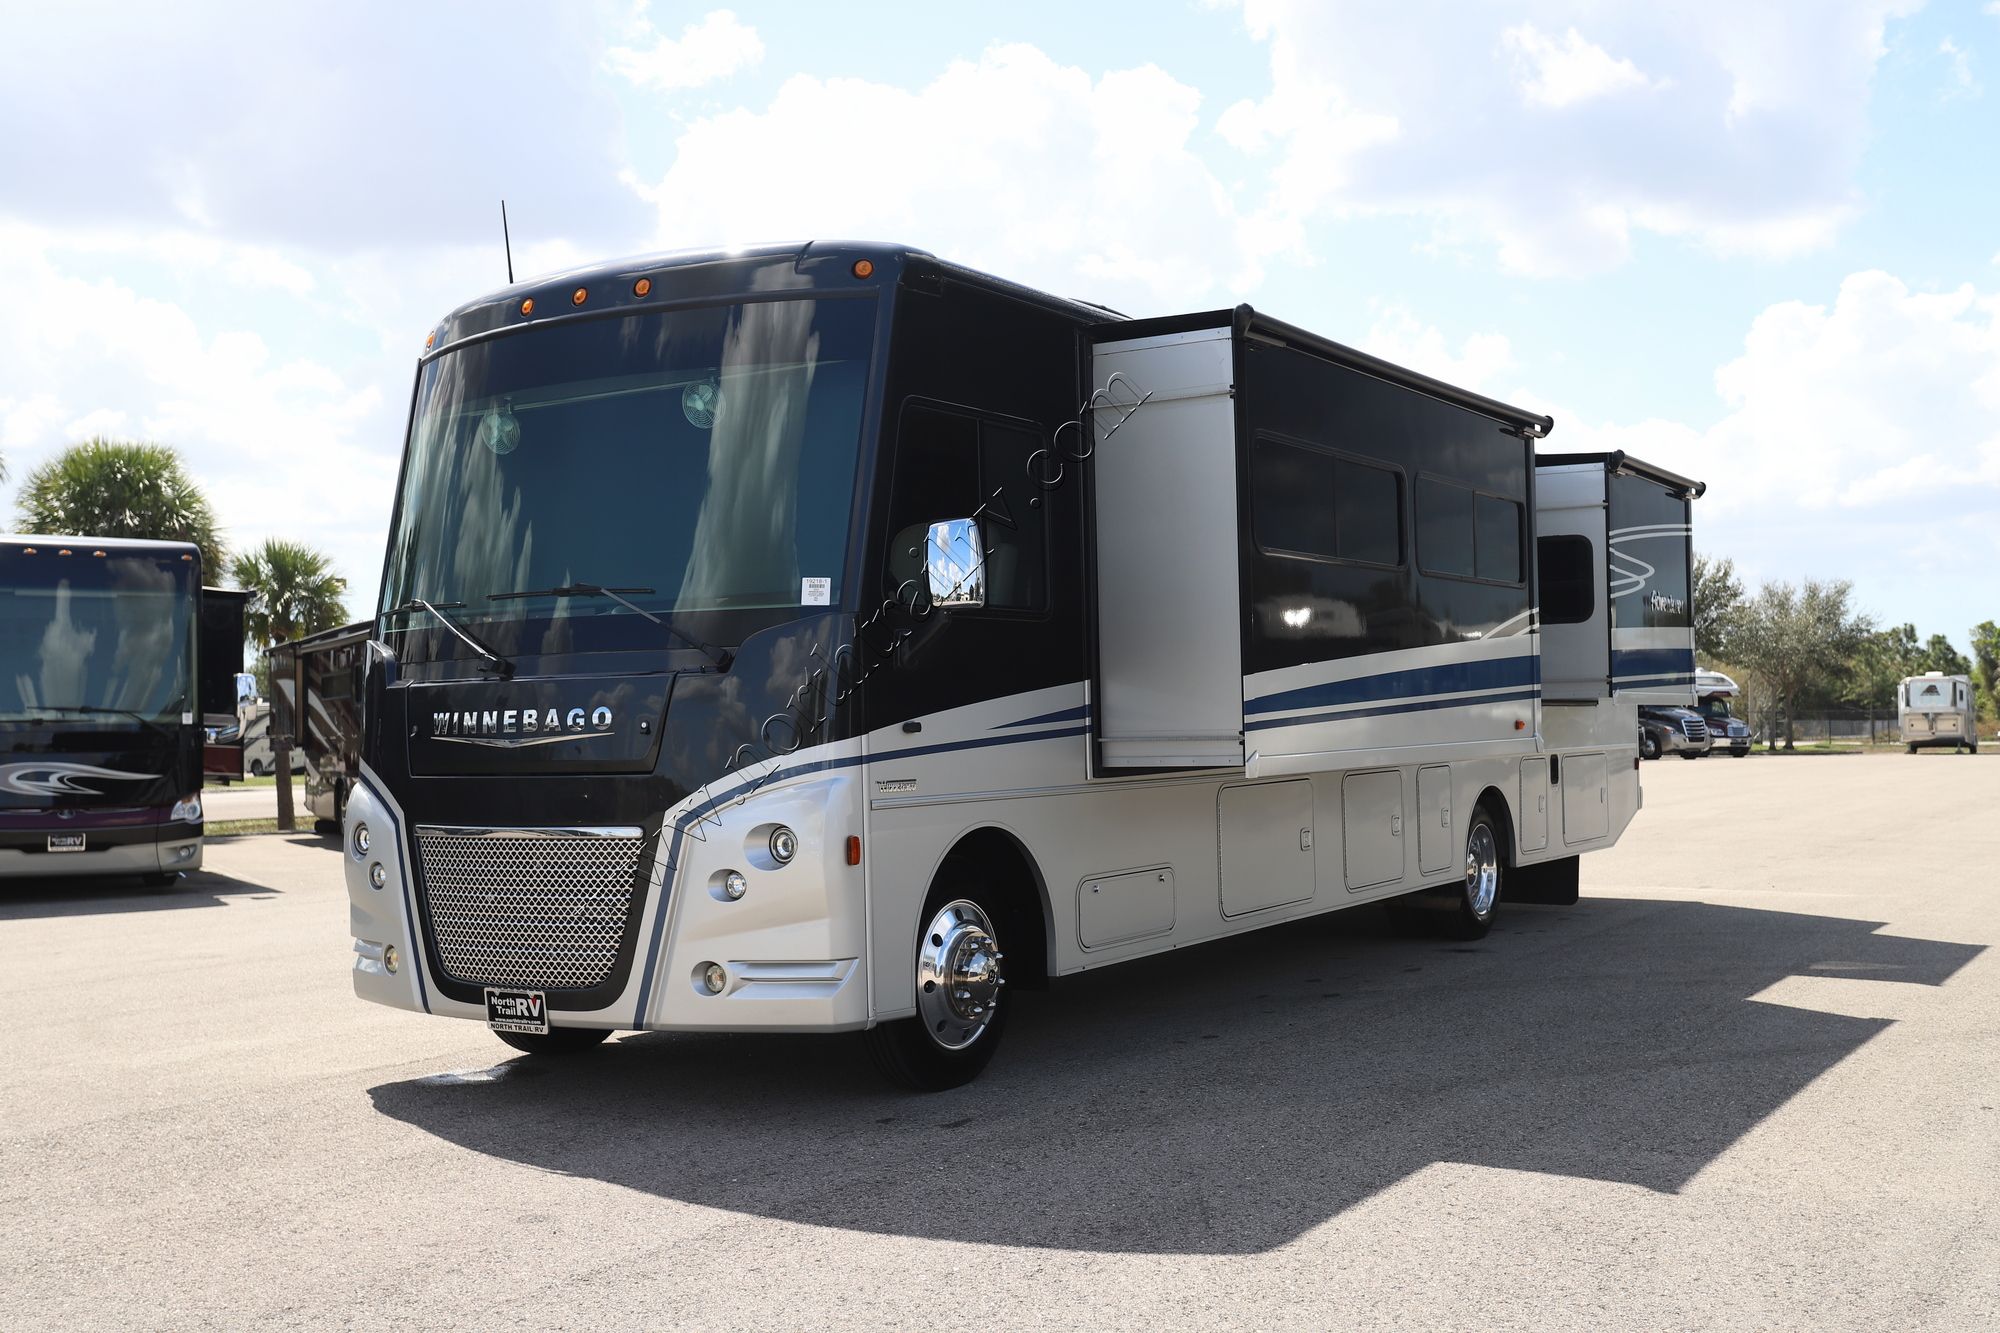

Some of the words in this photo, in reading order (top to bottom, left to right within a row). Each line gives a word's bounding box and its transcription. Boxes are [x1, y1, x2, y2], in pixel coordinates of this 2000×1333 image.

[433, 706, 613, 735] WINNEBAGO
[67, 836, 82, 845] RV
[491, 996, 515, 1006] North
[496, 1006, 516, 1015] Trail
[515, 998, 541, 1017] RV
[490, 1023, 513, 1031] NORTH
[514, 1024, 533, 1032] TRAIL
